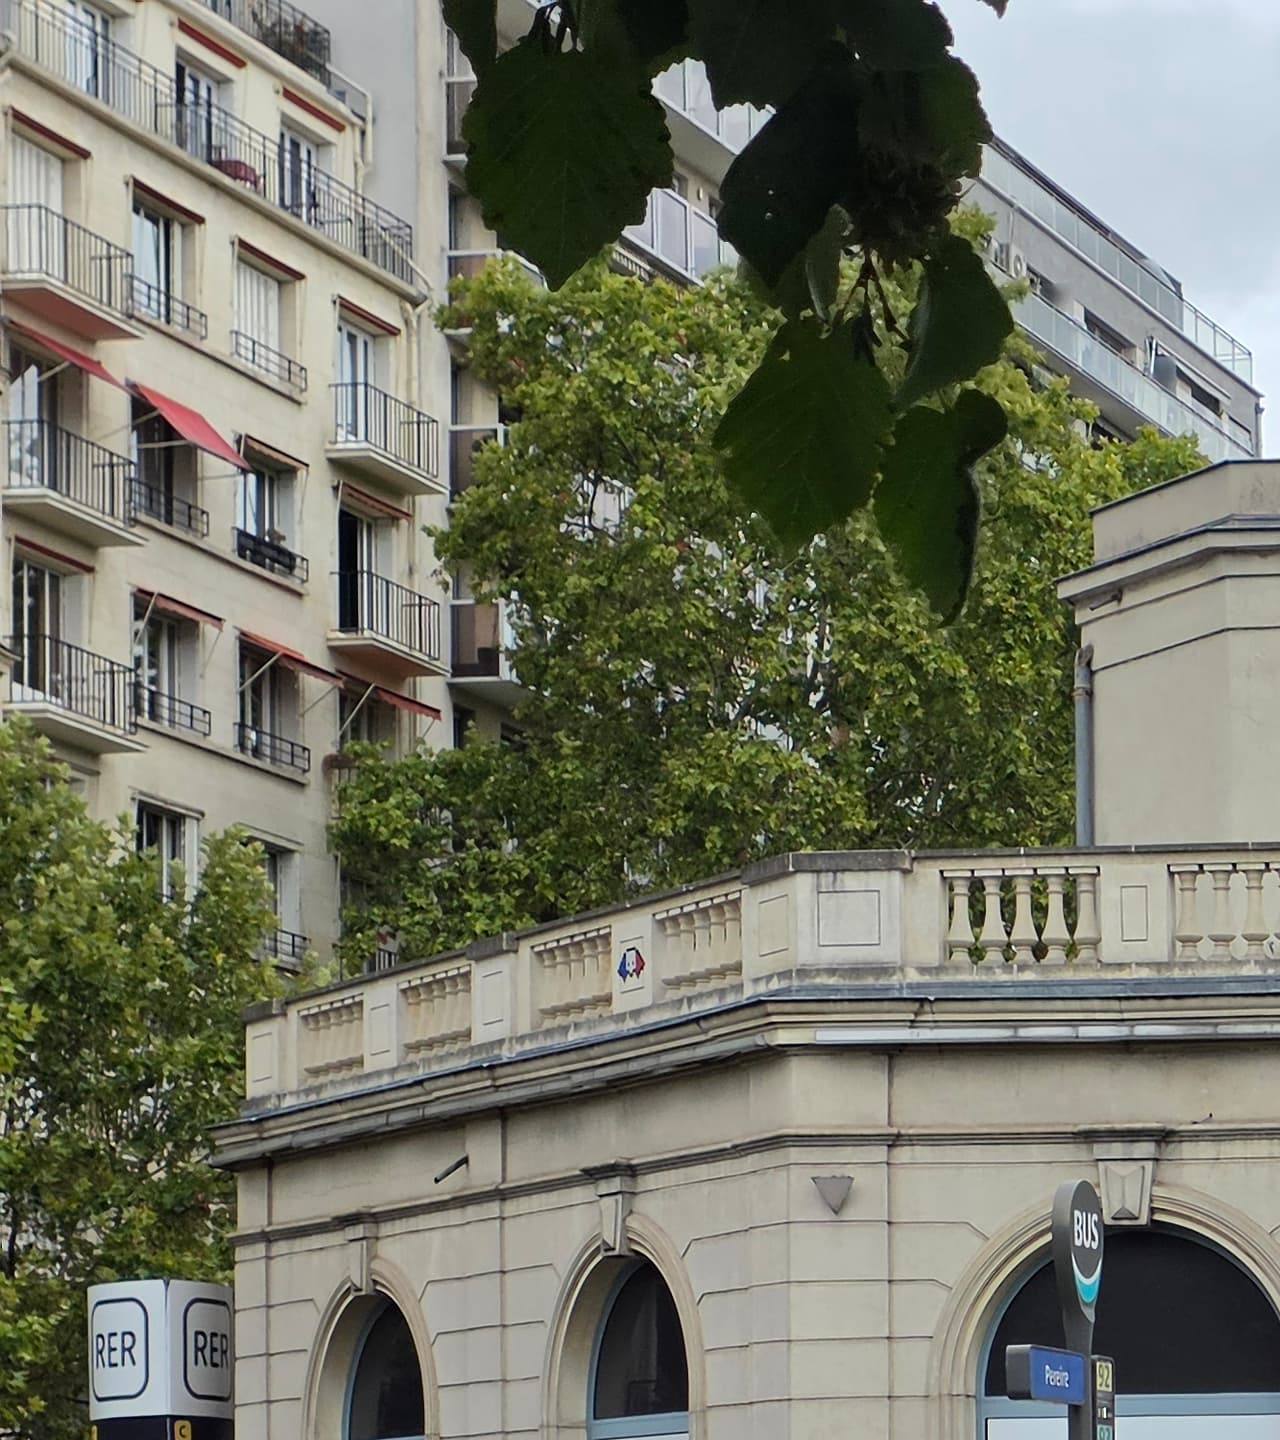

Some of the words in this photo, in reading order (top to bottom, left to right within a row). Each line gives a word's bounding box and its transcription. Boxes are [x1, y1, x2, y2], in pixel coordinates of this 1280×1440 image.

[1073, 1209, 1099, 1250] BUS
[96, 1331, 136, 1368] RER
[194, 1331, 228, 1367] RER
[1044, 1364, 1069, 1388] Pereire
[1098, 1363, 1111, 1388] 92
[179, 1425, 187, 1438] C
